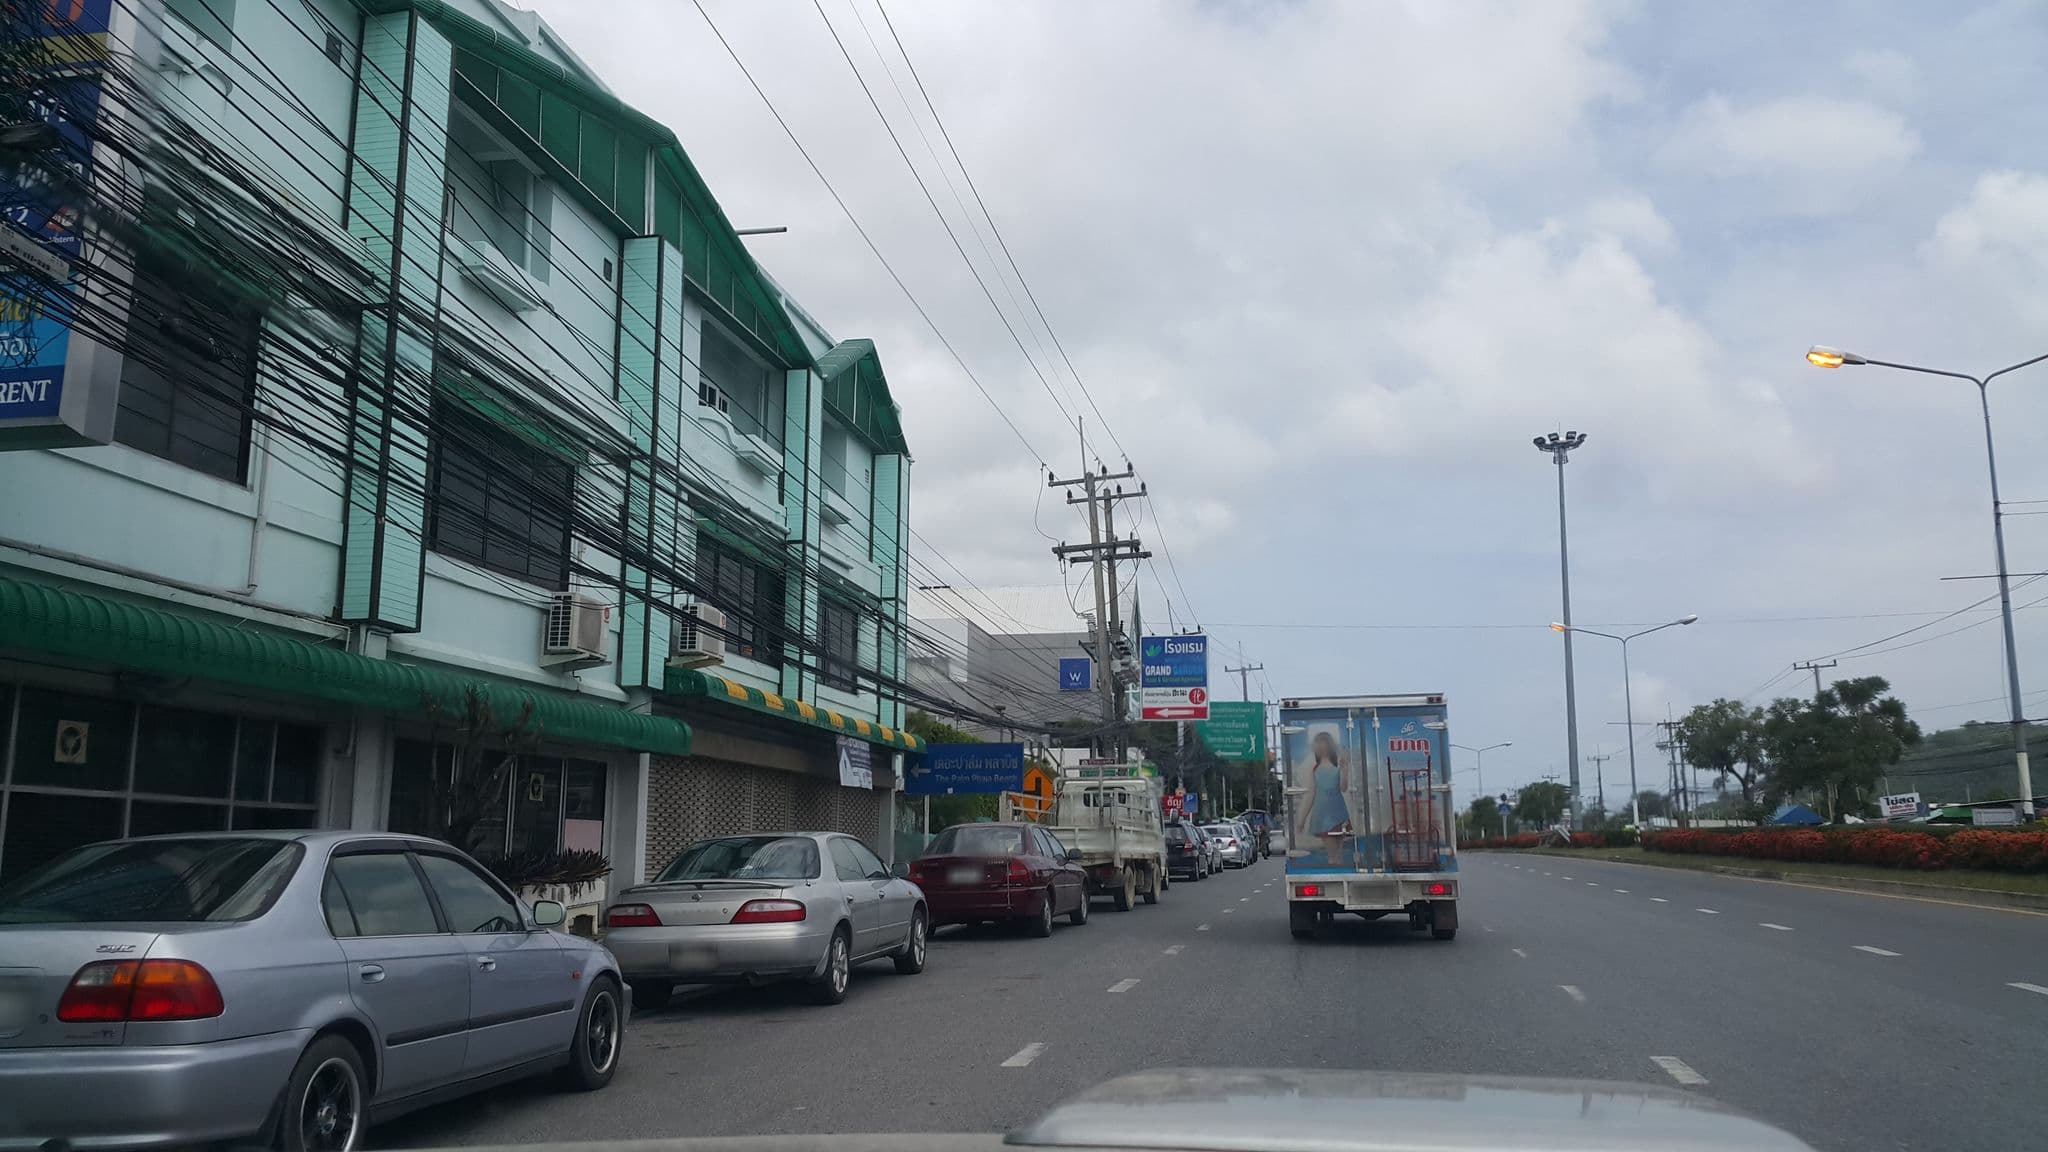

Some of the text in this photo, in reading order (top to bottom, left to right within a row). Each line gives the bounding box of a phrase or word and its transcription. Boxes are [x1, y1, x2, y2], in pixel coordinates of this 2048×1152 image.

[1165, 638, 1204, 653] โรงแรม
[1145, 665, 1172, 676] GRAND
[935, 774, 949, 783] The
